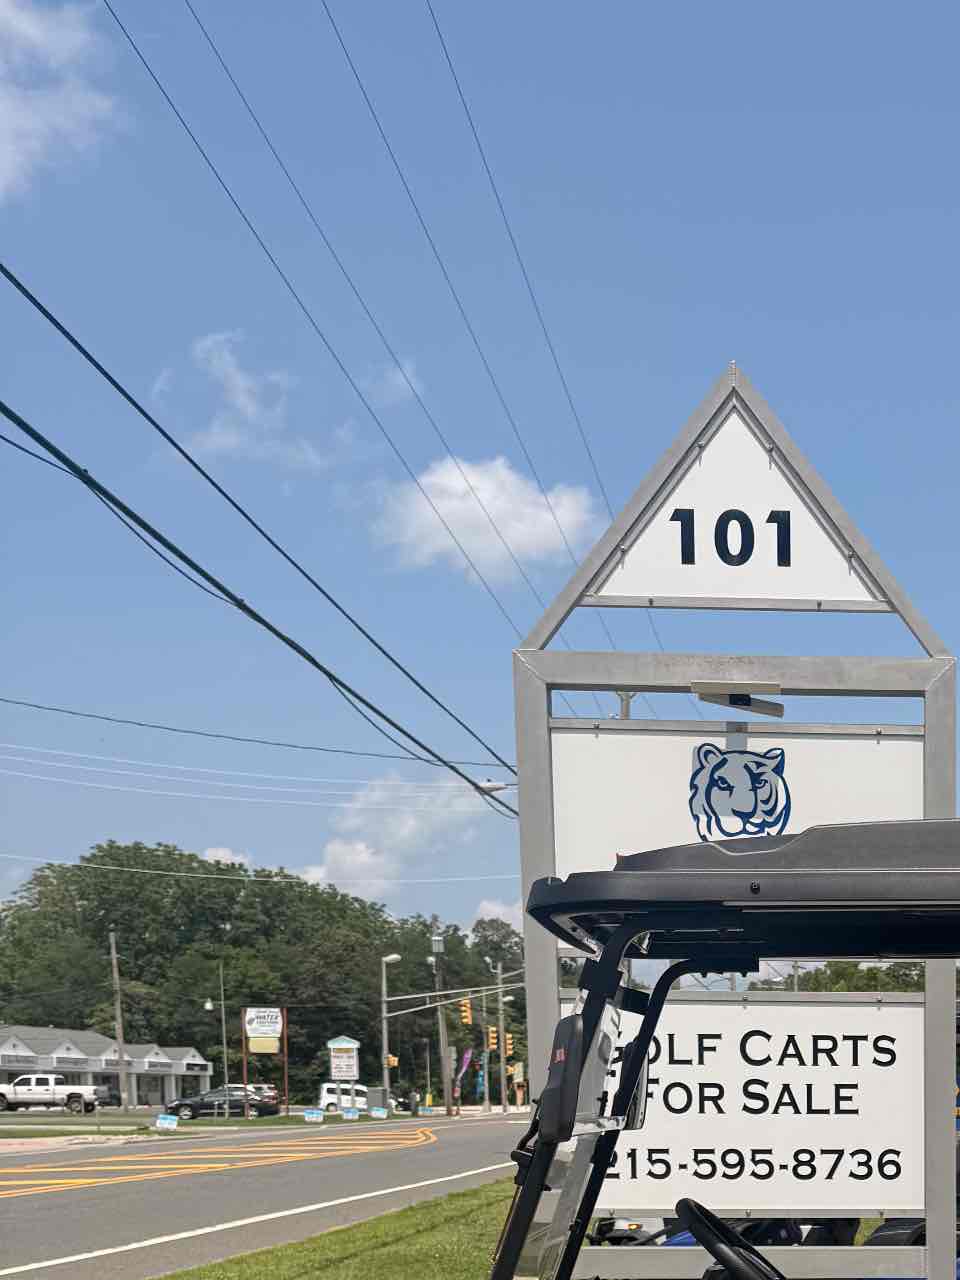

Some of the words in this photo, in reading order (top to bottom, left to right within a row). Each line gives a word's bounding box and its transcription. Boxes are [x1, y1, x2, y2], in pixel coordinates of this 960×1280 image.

[669, 508, 792, 568] 101
[739, 1029, 898, 1068] CARTS
[741, 1078, 860, 1115] SALE
[604, 1148, 902, 1181] 215-595-8736
